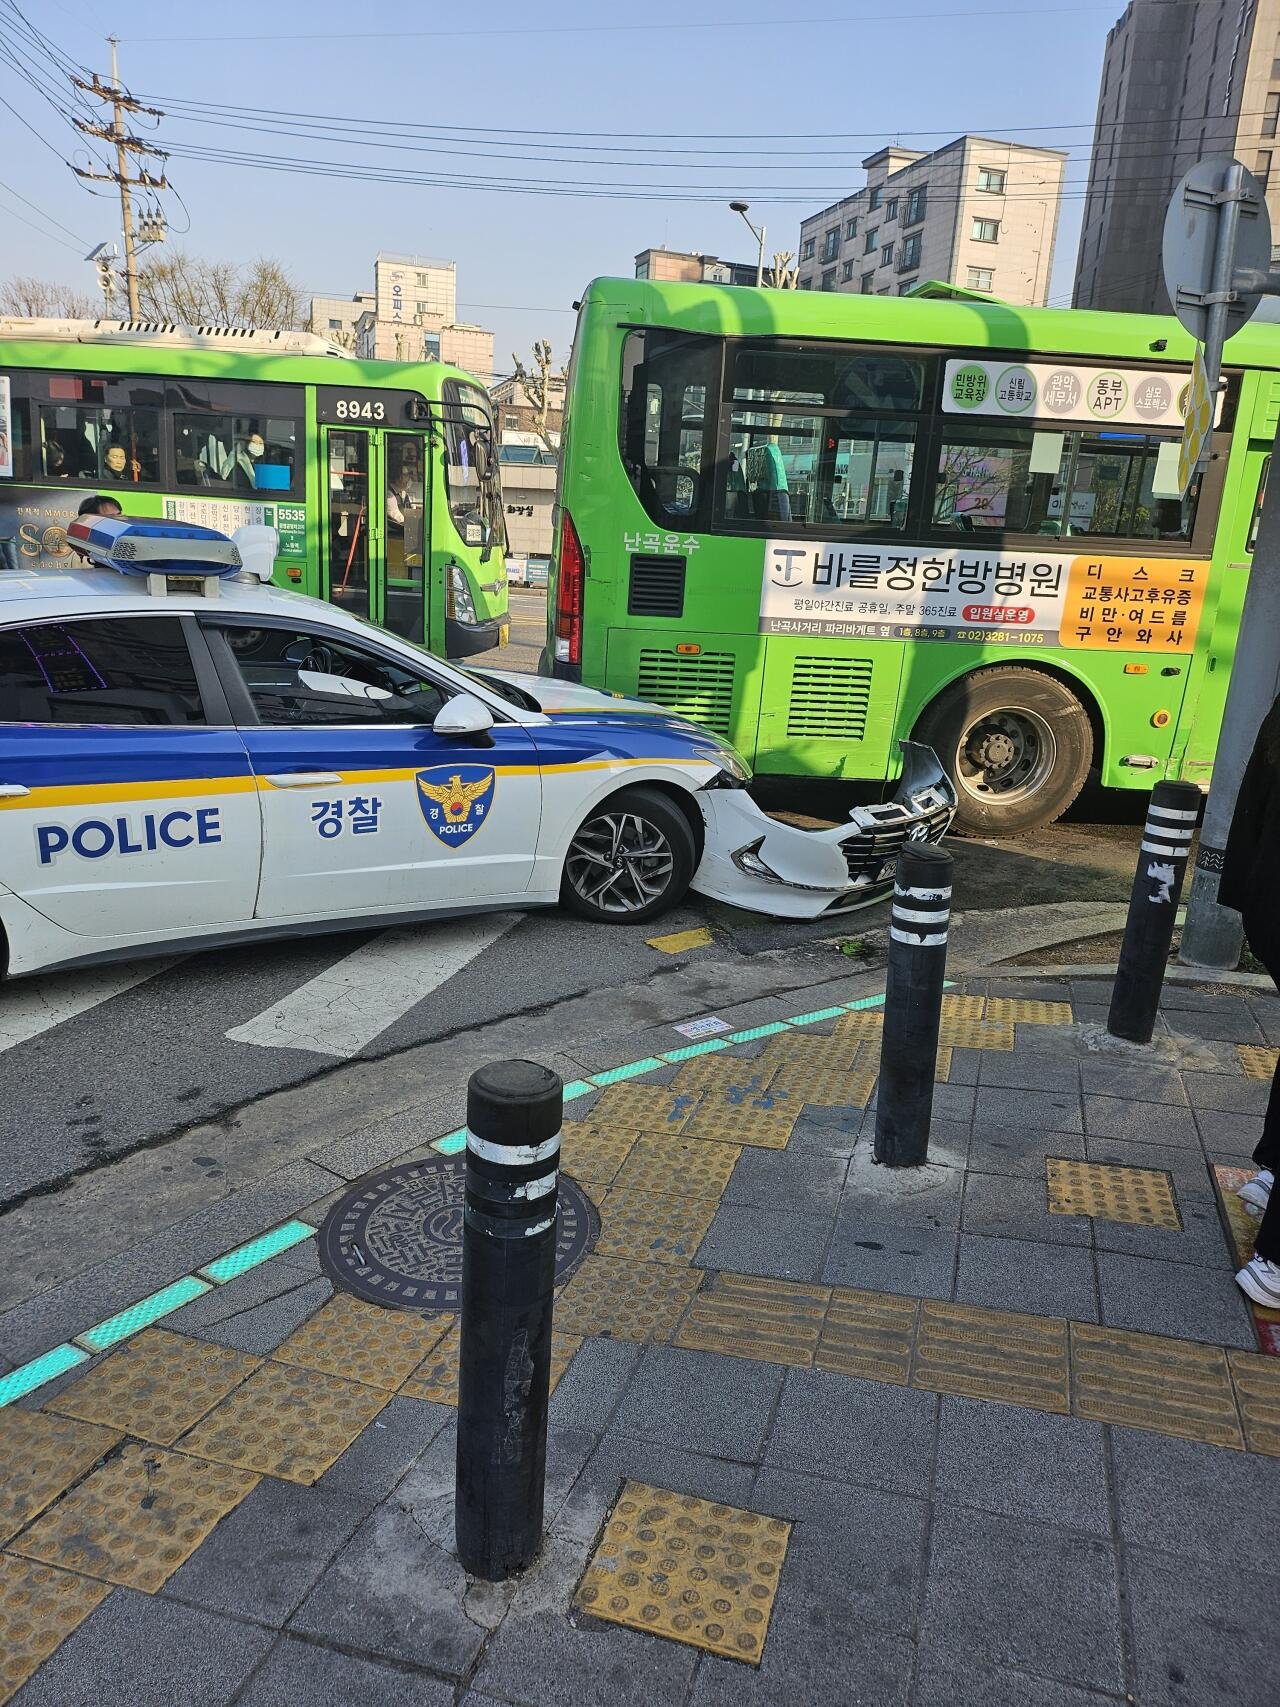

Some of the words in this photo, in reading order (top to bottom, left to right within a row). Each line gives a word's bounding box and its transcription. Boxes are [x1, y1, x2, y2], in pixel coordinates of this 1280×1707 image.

[956, 374, 987, 388] 민방위
[1009, 378, 1026, 389] 신림
[1051, 375, 1075, 392] 관악
[1097, 379, 1123, 396] 동부
[953, 388, 986, 402] 교육장
[999, 390, 1032, 402] 고등학교
[1044, 391, 1078, 408] 세무서
[1145, 386, 1162, 398] 삼모
[336, 400, 385, 420] 8943
[1092, 397, 1122, 411] APT
[278, 508, 305, 521] 5535
[623, 532, 701, 556] 난곡운수
[812, 552, 1063, 598] 바를정한방병원
[1082, 586, 1192, 606] 교통사고후유증
[794, 598, 854, 612] 평일야간진료
[858, 601, 891, 616] 공휴일,
[895, 603, 916, 616] 주말
[919, 605, 958, 618] 365진료
[969, 606, 1030, 623] 입원실운영
[770, 620, 822, 634] 난곡사거리
[824, 623, 877, 637] 파리바게트
[880, 625, 891, 638] 옆
[967, 629, 1044, 643] 02)3281-1075
[311, 796, 382, 839] 경찰
[429, 808, 439, 820] 경
[474, 803, 485, 816] 찰
[38, 807, 223, 865] POLICE
[439, 823, 474, 835] POLICE
